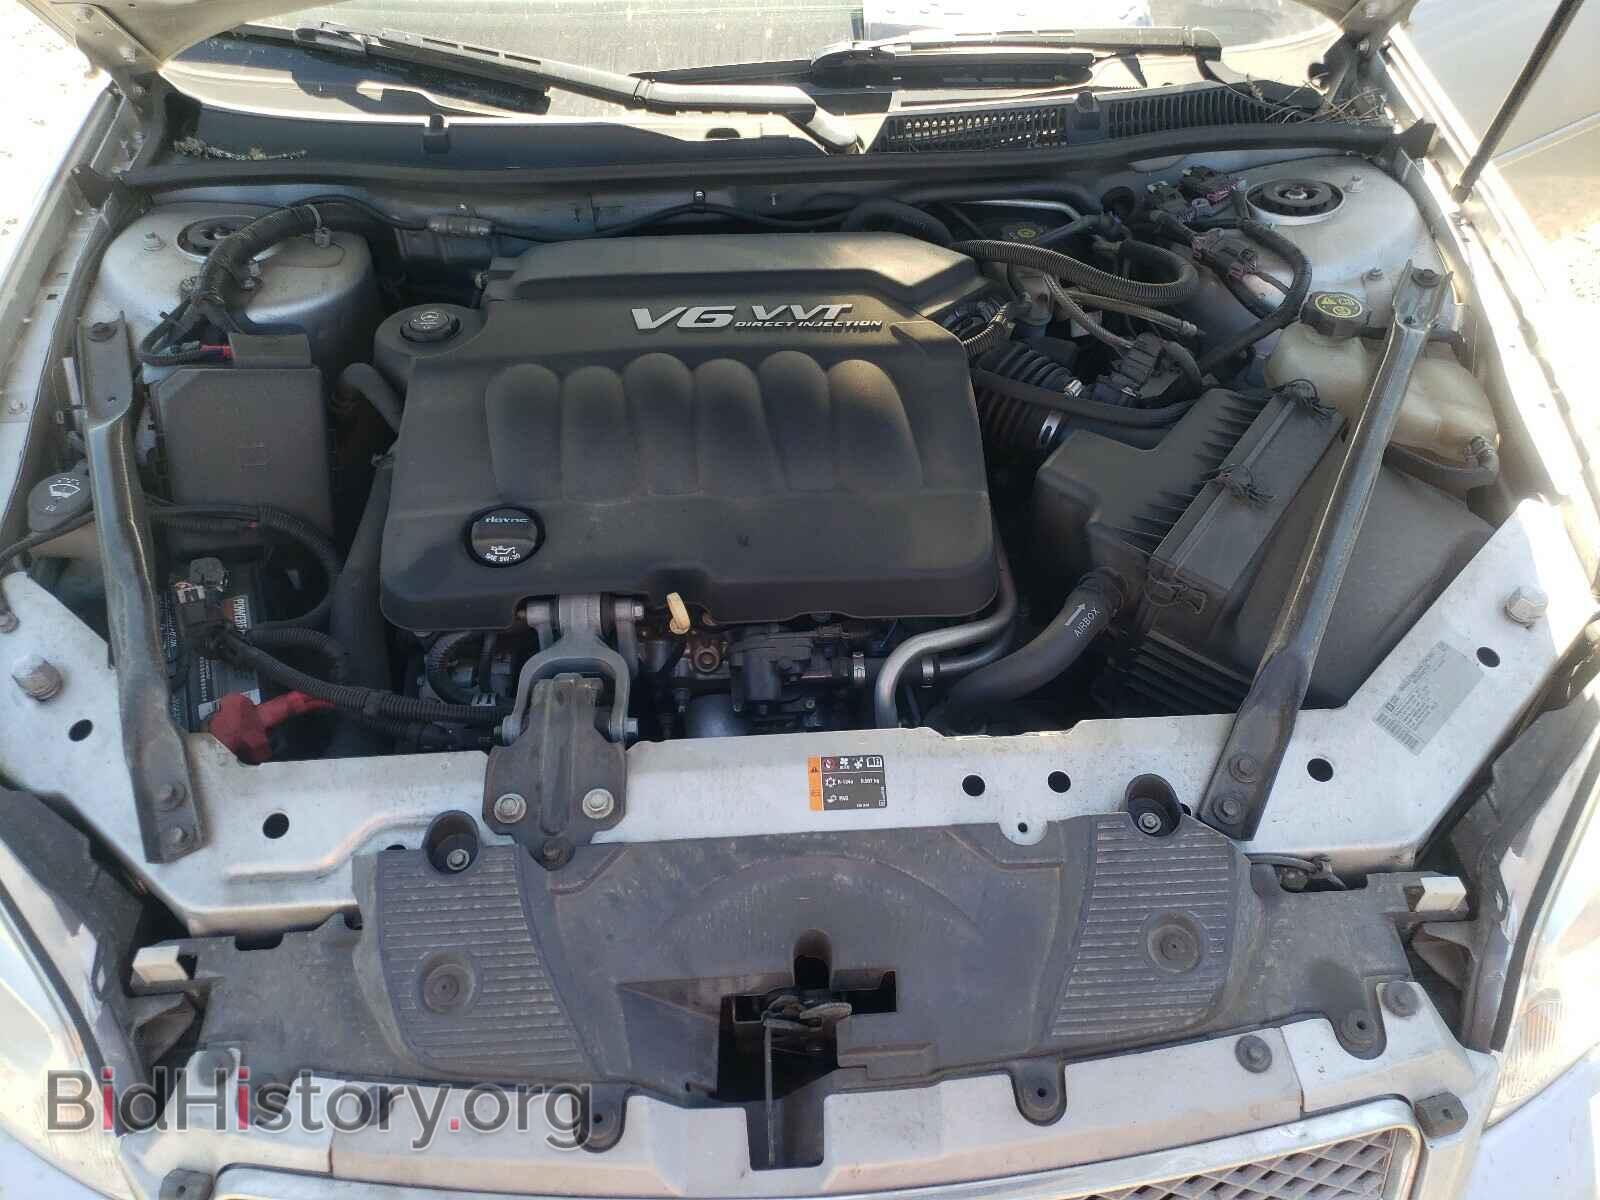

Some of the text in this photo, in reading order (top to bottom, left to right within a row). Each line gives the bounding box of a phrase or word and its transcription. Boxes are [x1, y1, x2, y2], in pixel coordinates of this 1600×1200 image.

[632, 303, 853, 330] V6 VVT
[798, 320, 883, 328] INJECTION
[1073, 607, 1098, 640] AIRBOX
